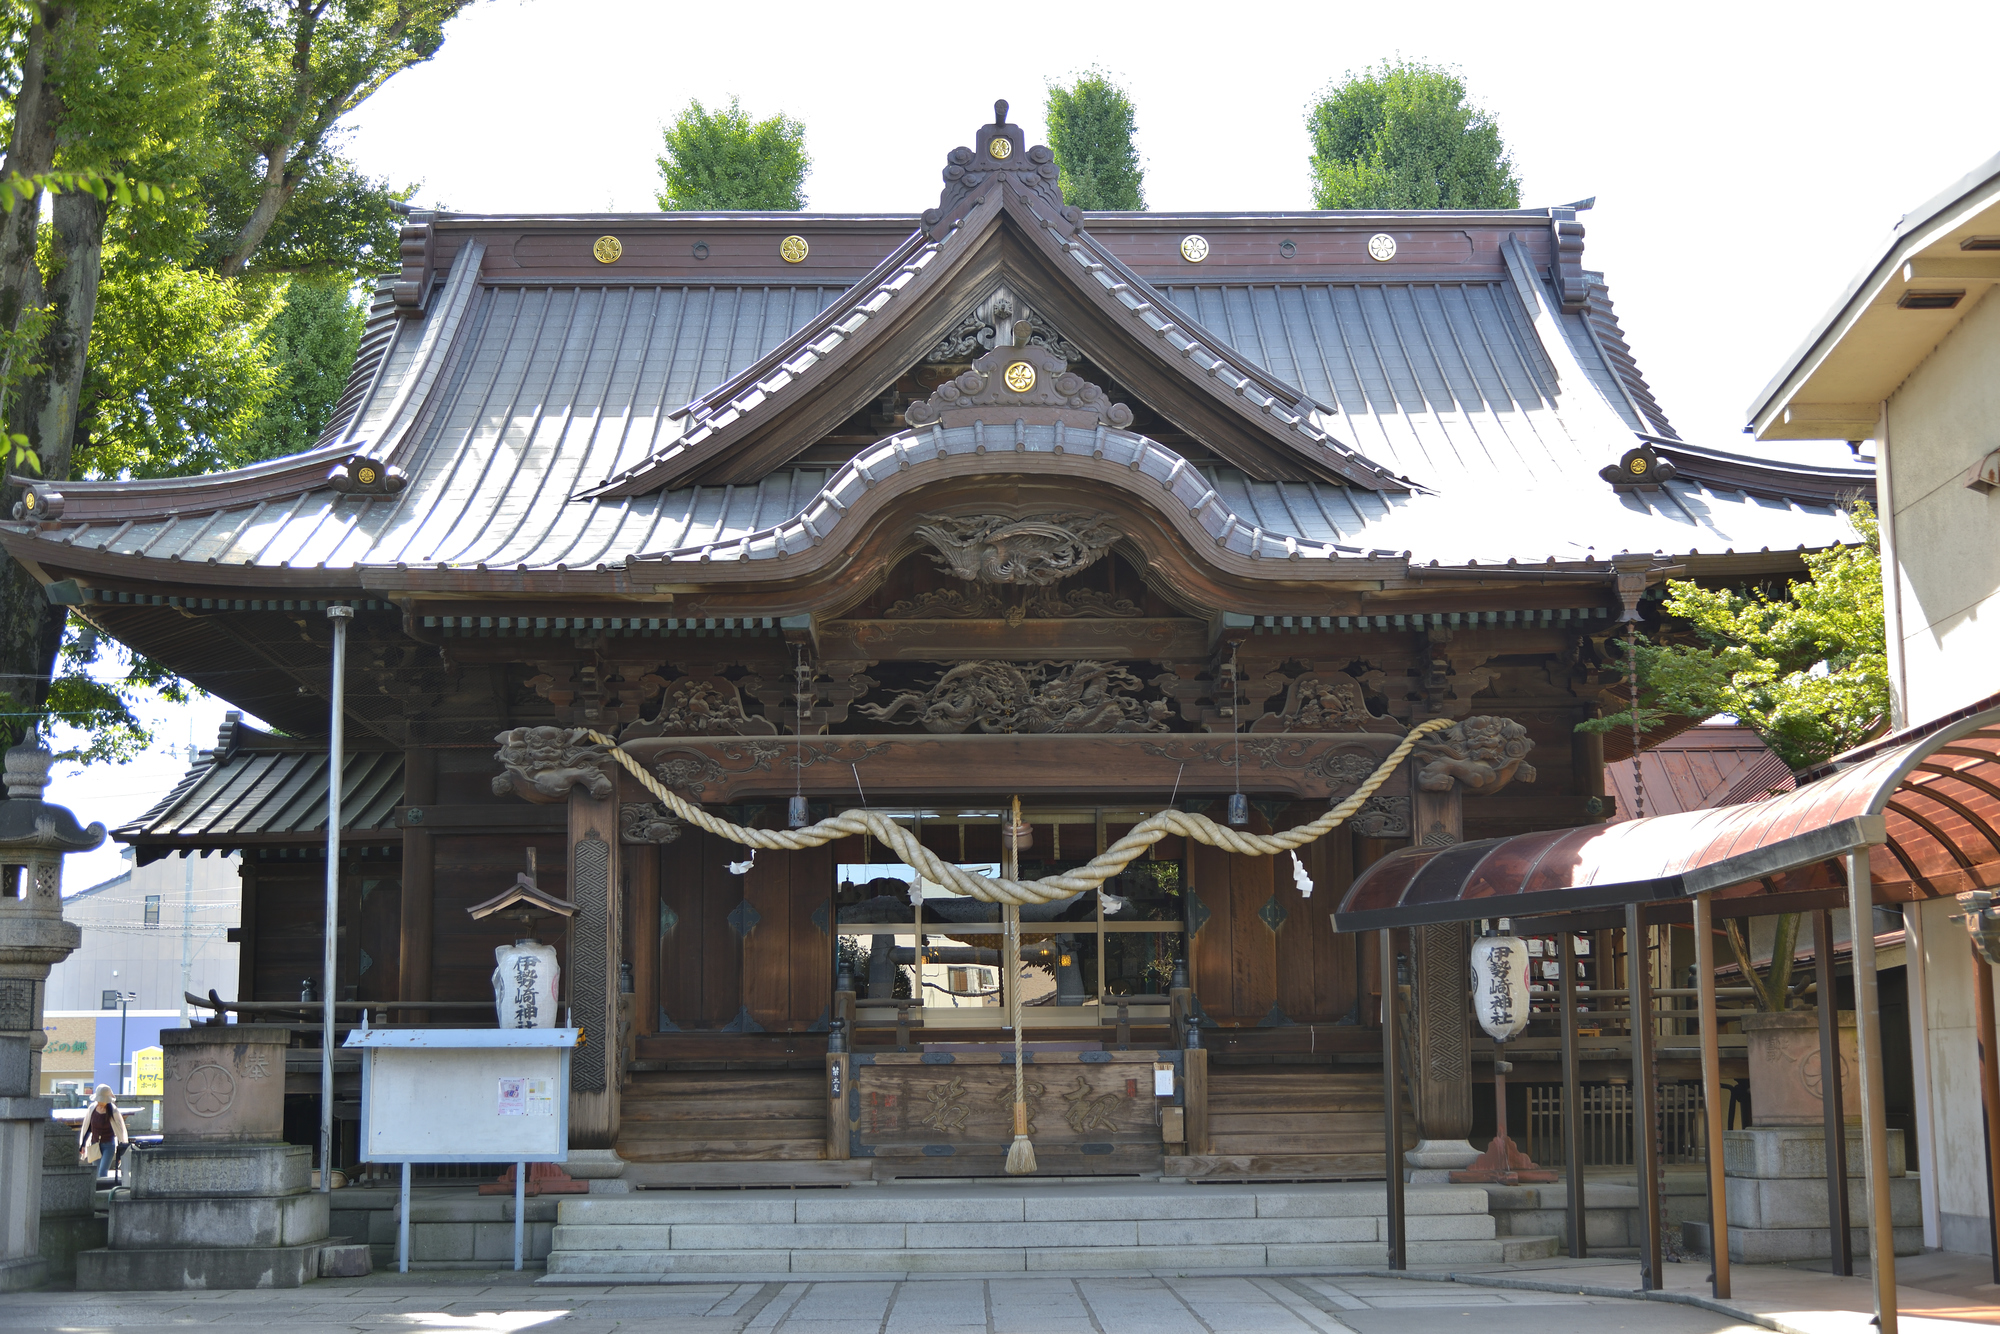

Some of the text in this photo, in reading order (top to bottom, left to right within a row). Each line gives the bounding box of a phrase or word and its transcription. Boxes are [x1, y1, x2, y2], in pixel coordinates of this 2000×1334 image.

[1487, 946, 1515, 1026] 伊勢崎神社
[241, 1051, 272, 1081] 奉
